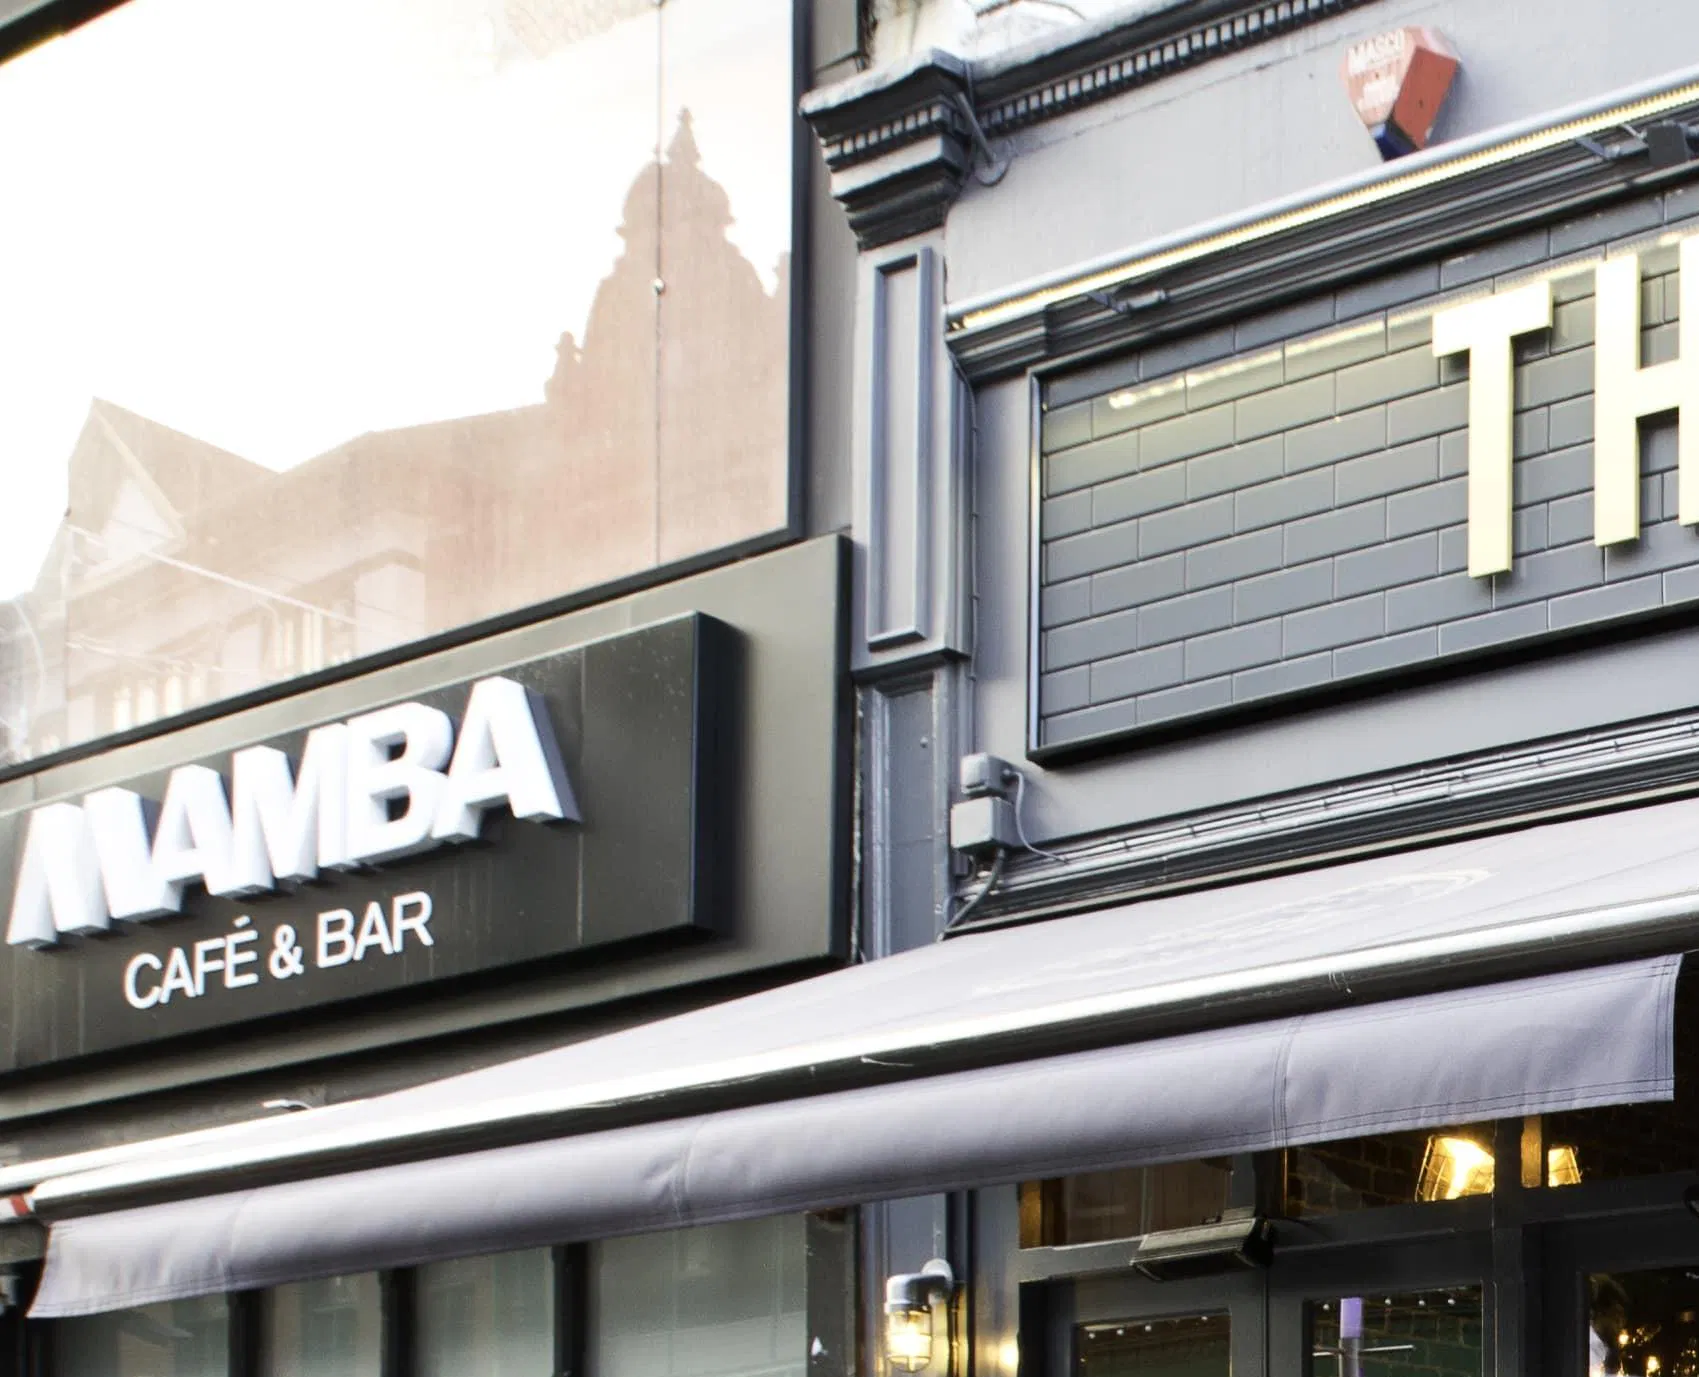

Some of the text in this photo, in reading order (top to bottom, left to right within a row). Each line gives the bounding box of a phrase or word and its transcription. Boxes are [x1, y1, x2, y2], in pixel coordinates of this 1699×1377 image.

[6, 675, 583, 950] MAMBA
[124, 890, 434, 1009] CAFÉ & BAR
